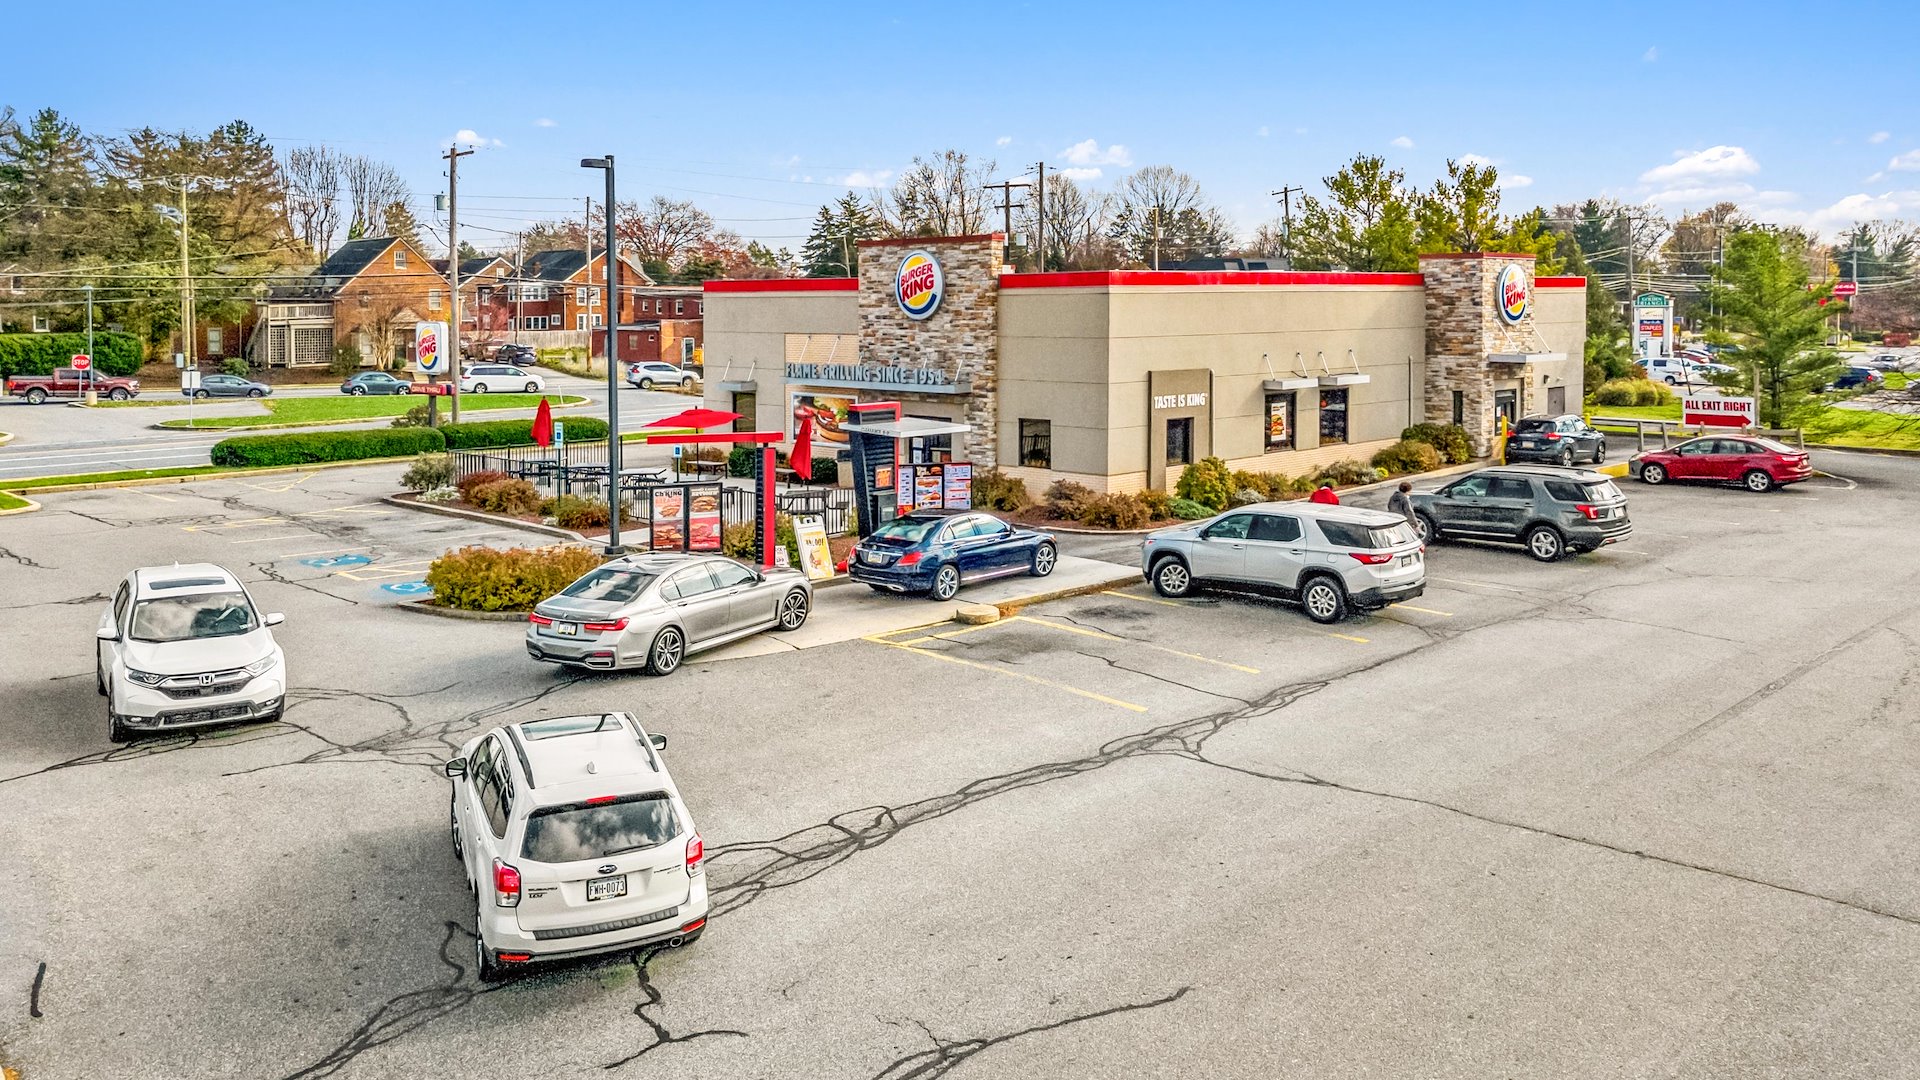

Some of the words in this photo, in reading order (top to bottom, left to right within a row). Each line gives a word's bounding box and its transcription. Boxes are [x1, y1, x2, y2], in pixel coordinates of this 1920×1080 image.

[901, 263, 933, 287] BURGER
[902, 274, 934, 303] KING
[1505, 291, 1525, 309] KING
[418, 342, 436, 358] KING
[787, 363, 817, 378] FLAME
[823, 365, 871, 382] GRILLING
[876, 367, 907, 384] SINCE
[913, 368, 943, 385] 1954
[1154, 395, 1177, 409] TASTE
[1177, 394, 1185, 408] IS
[1685, 400, 1700, 410] ALL
[1702, 401, 1721, 411] EXIT
[1723, 401, 1752, 412] RIGHT
[589, 881, 625, 896] FWH-0073
